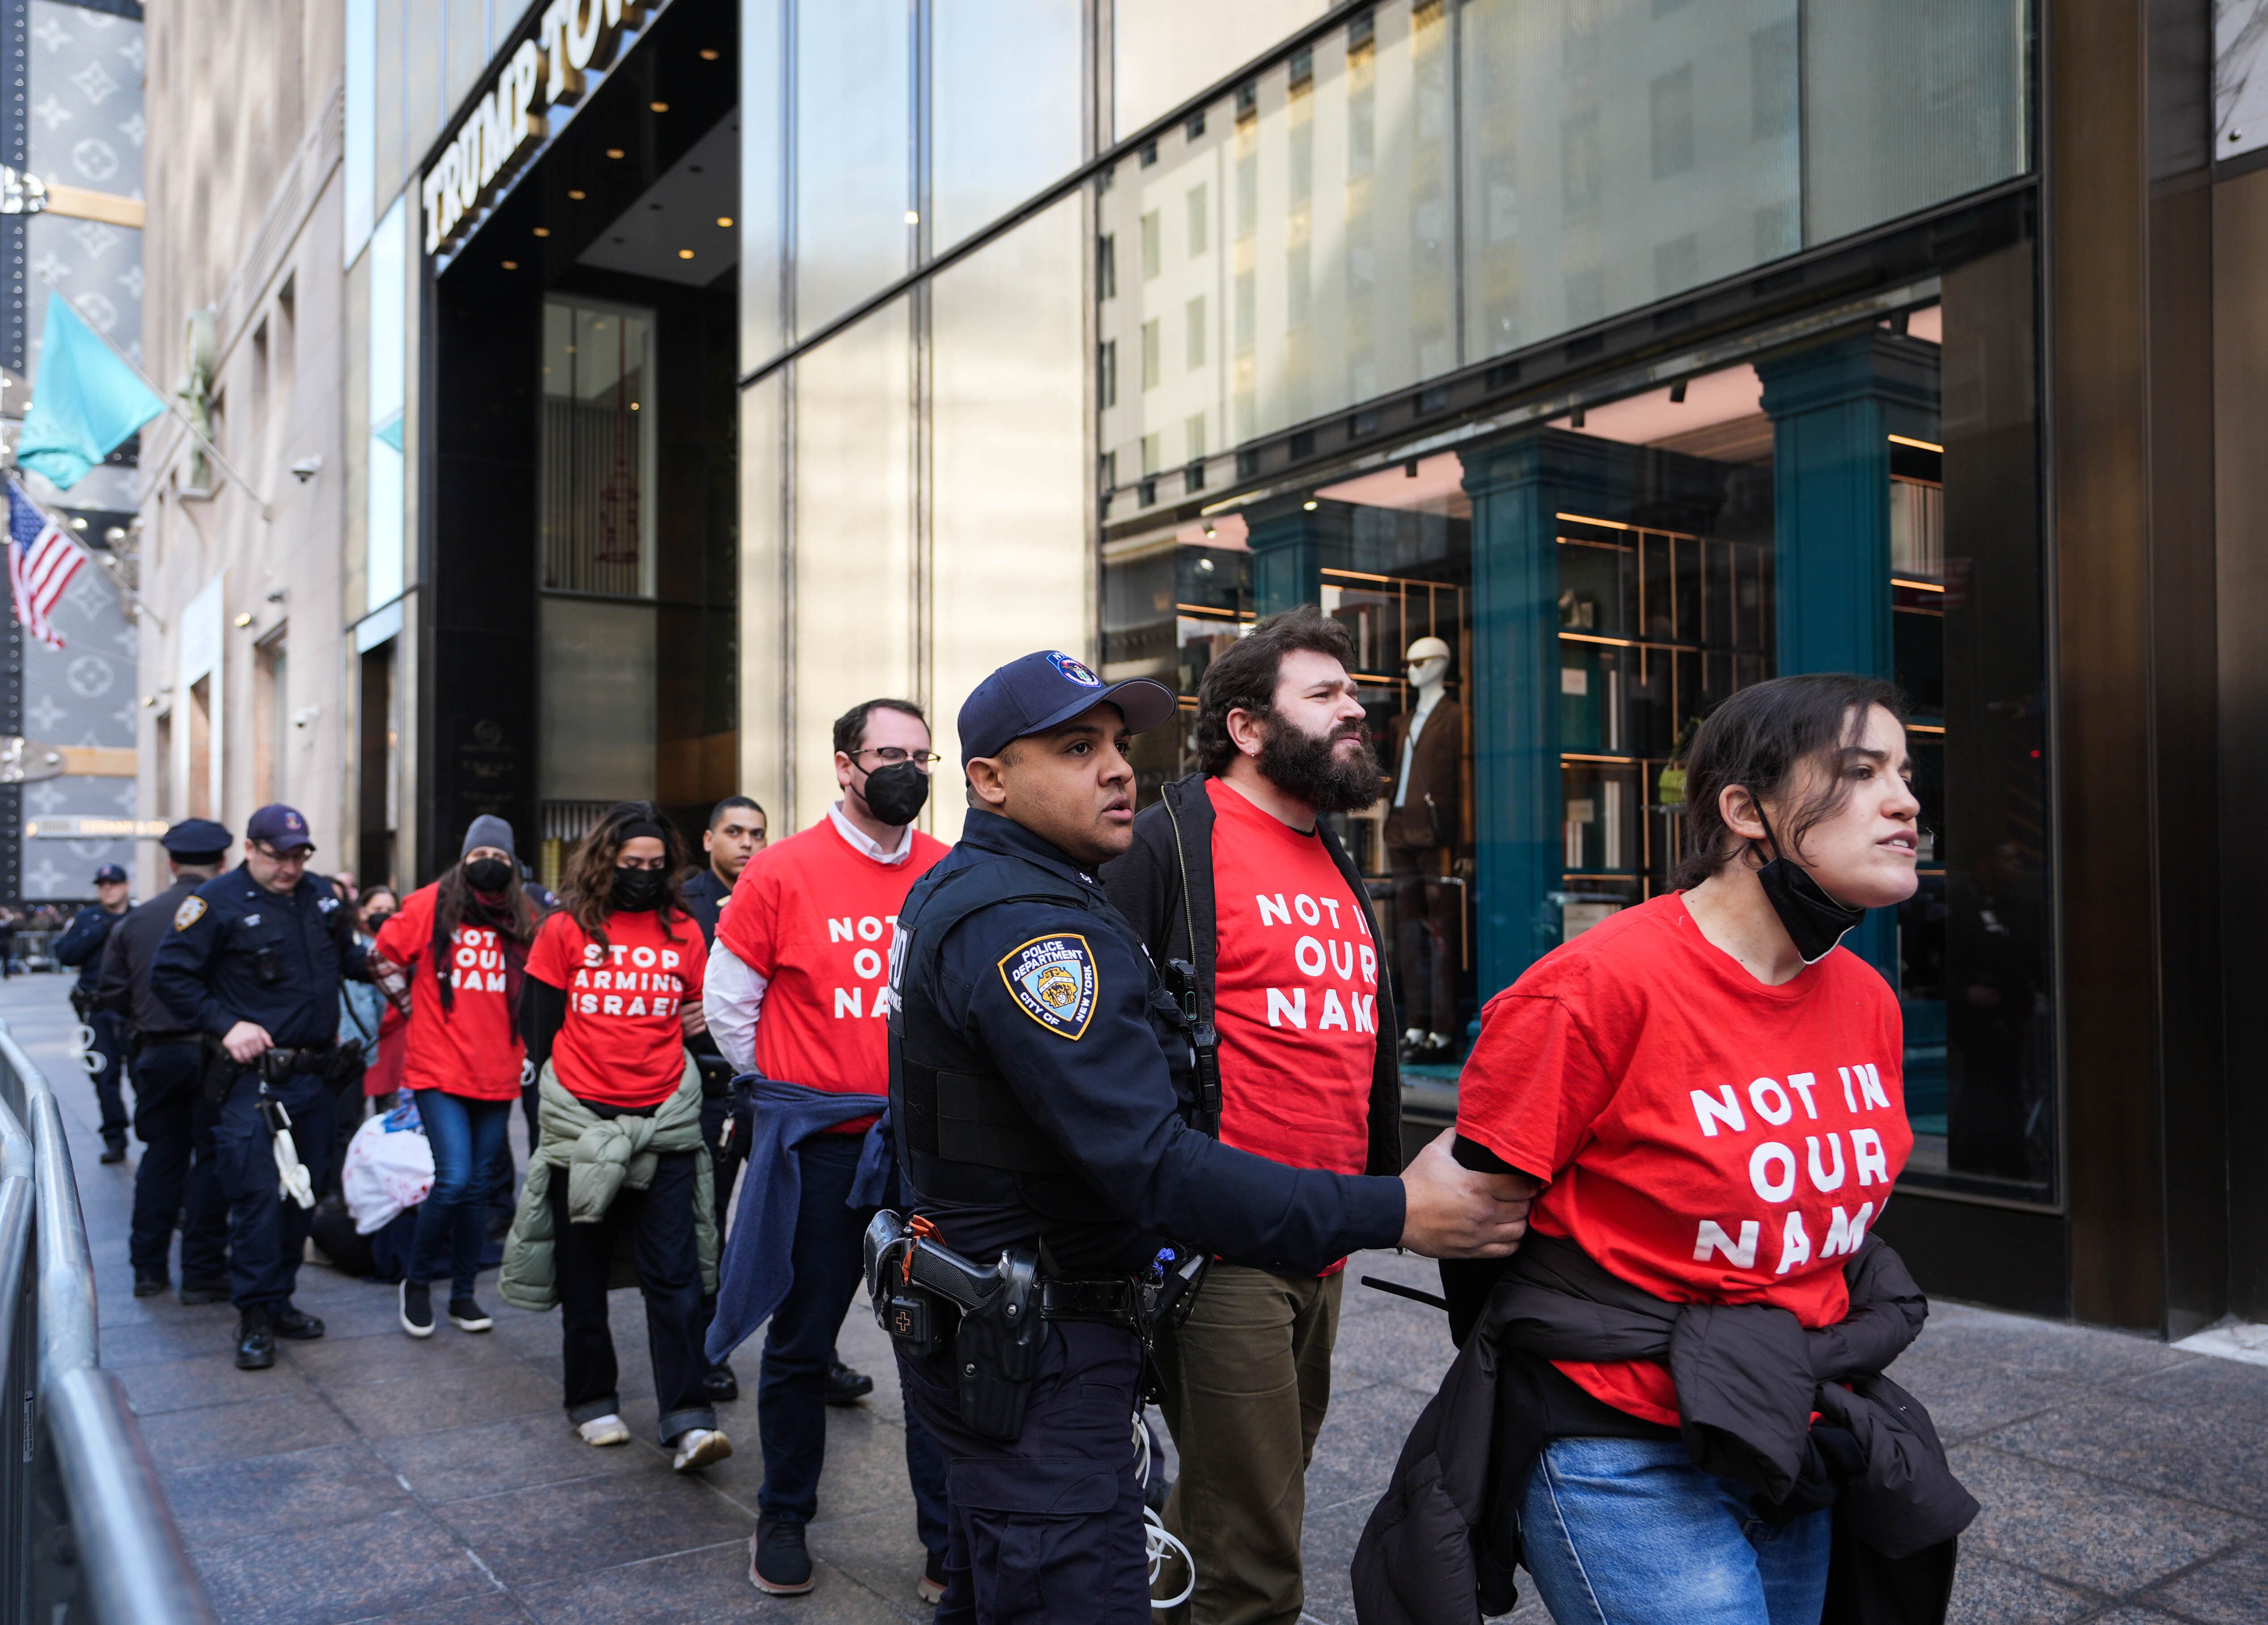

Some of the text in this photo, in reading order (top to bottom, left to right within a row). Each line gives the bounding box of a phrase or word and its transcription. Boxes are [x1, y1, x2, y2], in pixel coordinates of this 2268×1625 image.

[423, 39, 538, 255] TRUMP
[1256, 893, 1372, 939] NOT I
[584, 944, 680, 969] STOP
[853, 948, 891, 979] O
[888, 924, 907, 990] PD
[1012, 950, 1083, 982] DEPARTMENT
[1022, 941, 1064, 962] POLICE
[1295, 935, 1377, 986] OUR
[450, 969, 506, 993] AM
[574, 969, 683, 992] ARMING
[835, 986, 888, 1018] NA
[1076, 965, 1092, 1023] NEW YORK
[1020, 992, 1060, 1025] CITY OF
[1267, 988, 1375, 1034] NAM
[1690, 1063, 1890, 1136] NOT IN
[1749, 1128, 1889, 1202] OUR
[1692, 1197, 1888, 1274] NAM
